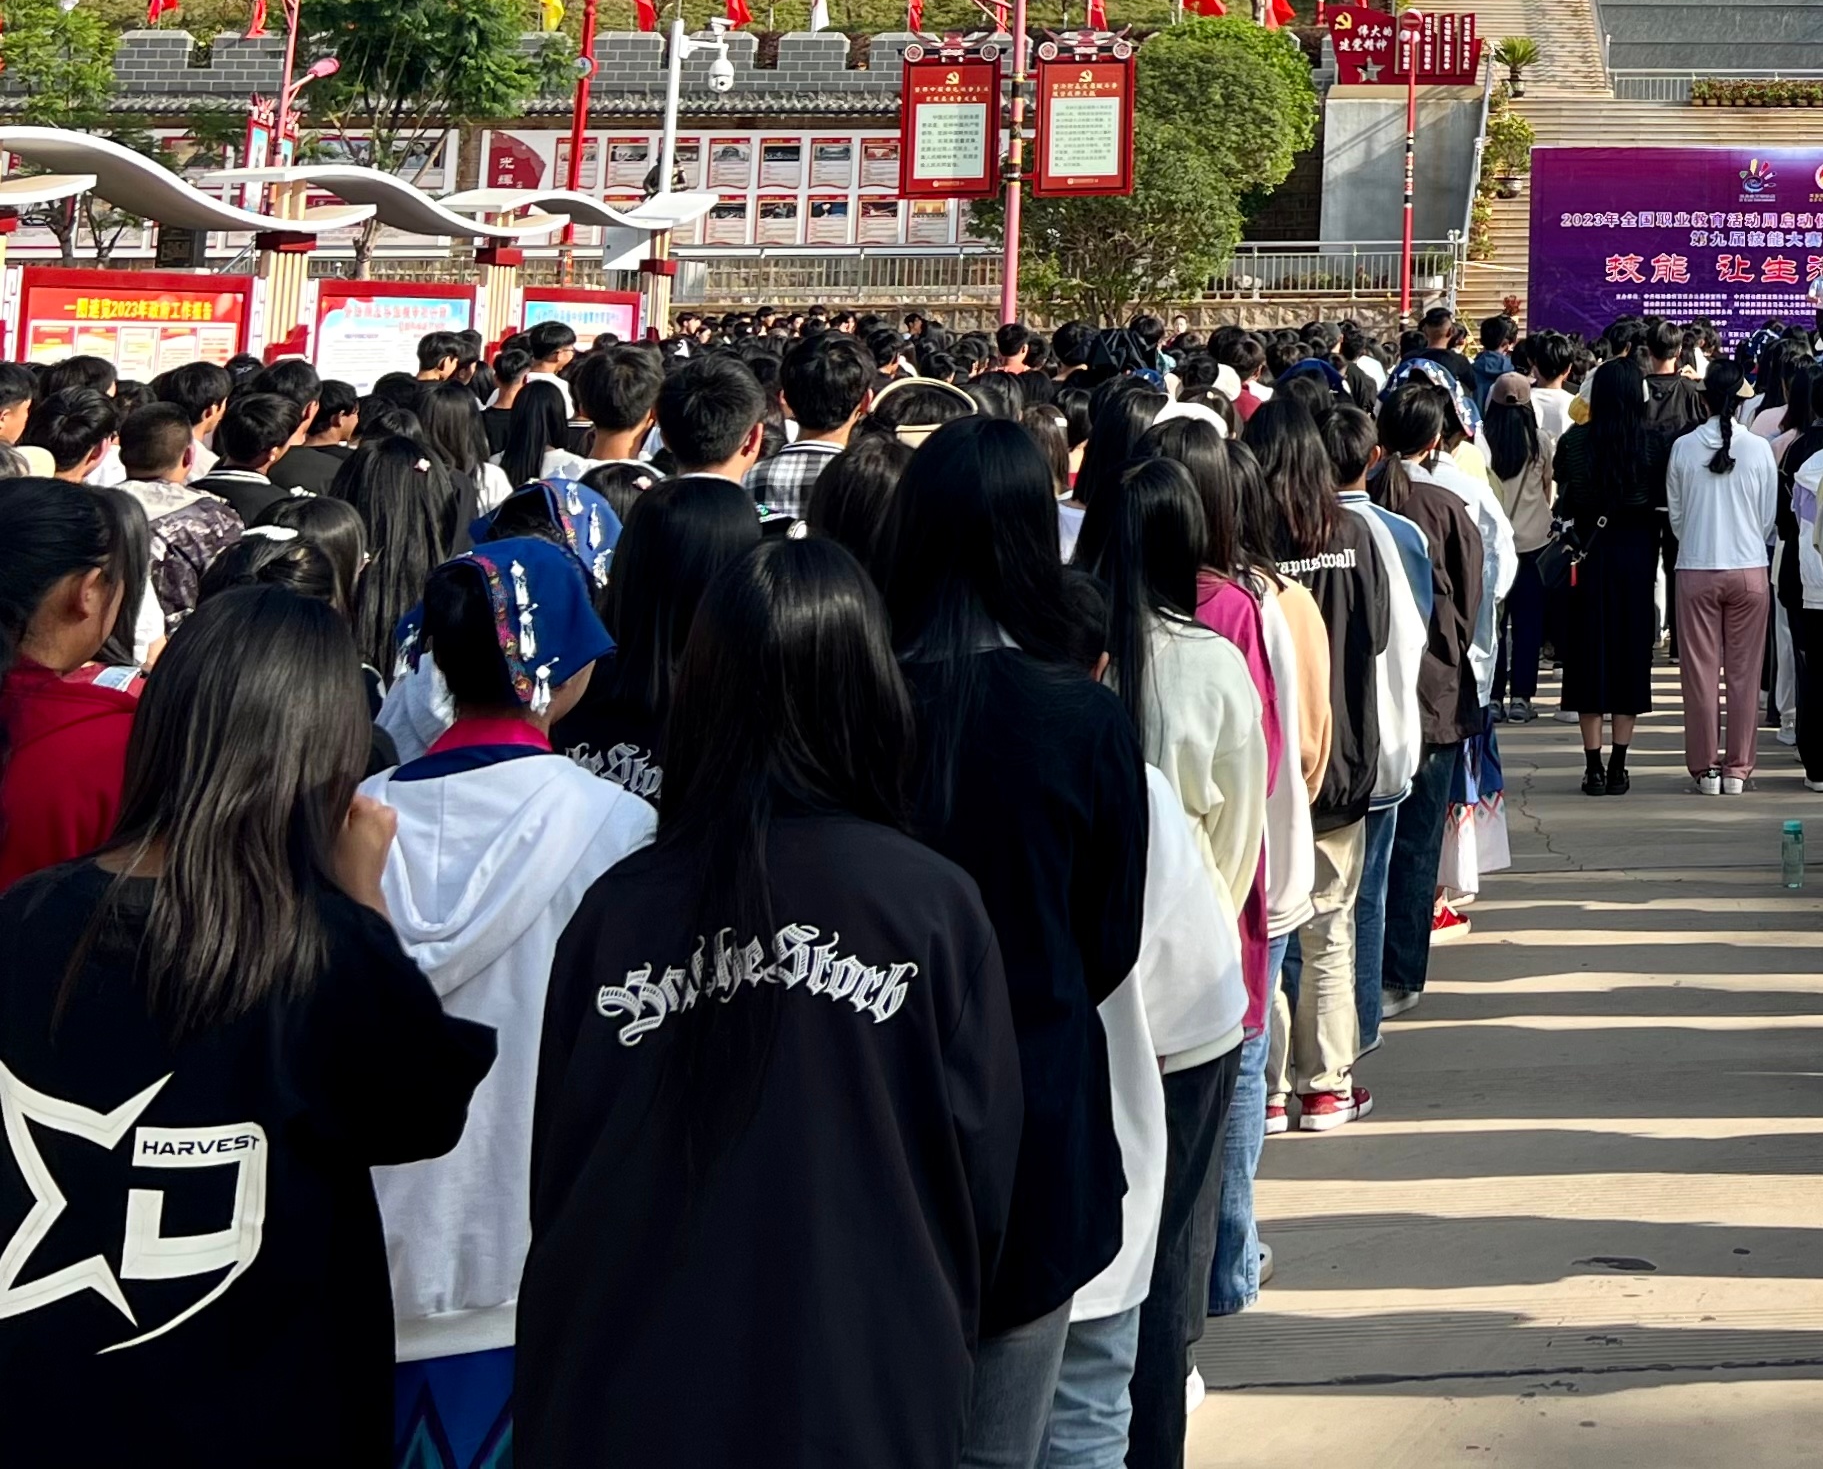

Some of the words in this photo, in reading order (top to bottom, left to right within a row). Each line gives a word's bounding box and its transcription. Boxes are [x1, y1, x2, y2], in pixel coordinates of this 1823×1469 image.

[1356, 24, 1393, 38] 伟大的
[1338, 38, 1388, 52] 建党精神
[1605, 253, 1692, 284] 技能
[142, 1134, 261, 1157] HARVEST
